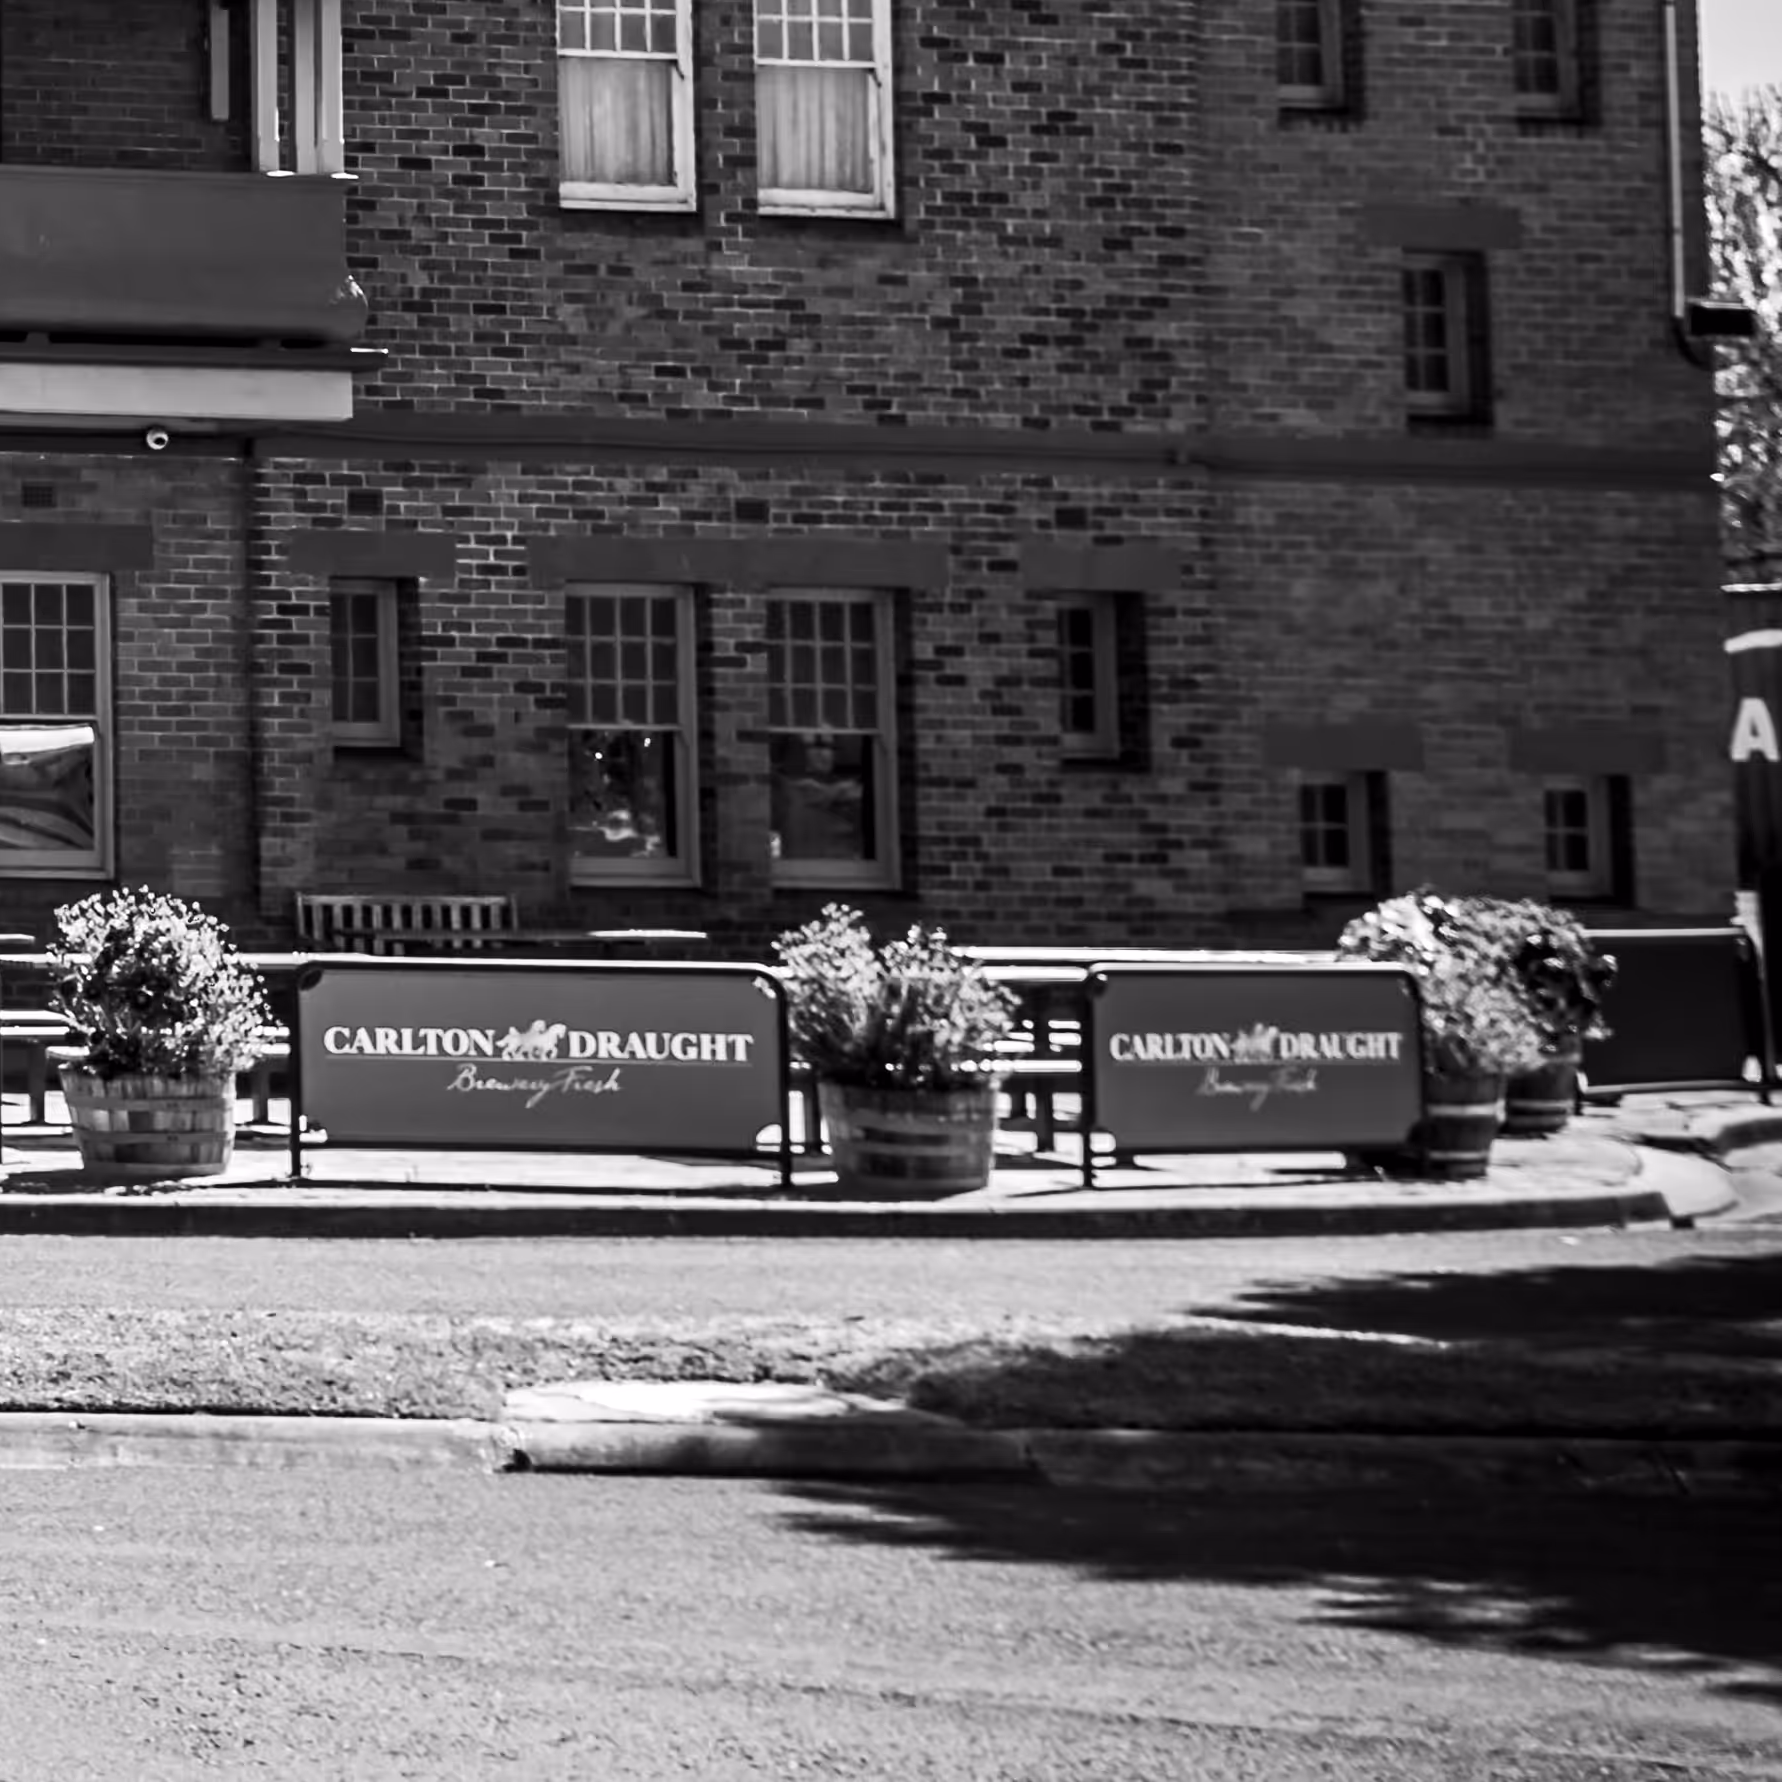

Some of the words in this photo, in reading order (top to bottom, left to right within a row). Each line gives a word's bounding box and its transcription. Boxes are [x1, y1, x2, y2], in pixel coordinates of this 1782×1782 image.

[323, 1026, 497, 1056] CARLTON
[568, 1030, 755, 1062] DRAUGHT
[1109, 1031, 1230, 1061] CARLTON
[1279, 1031, 1403, 1061] DRAUGHT
[550, 1065, 623, 1093] Fresh
